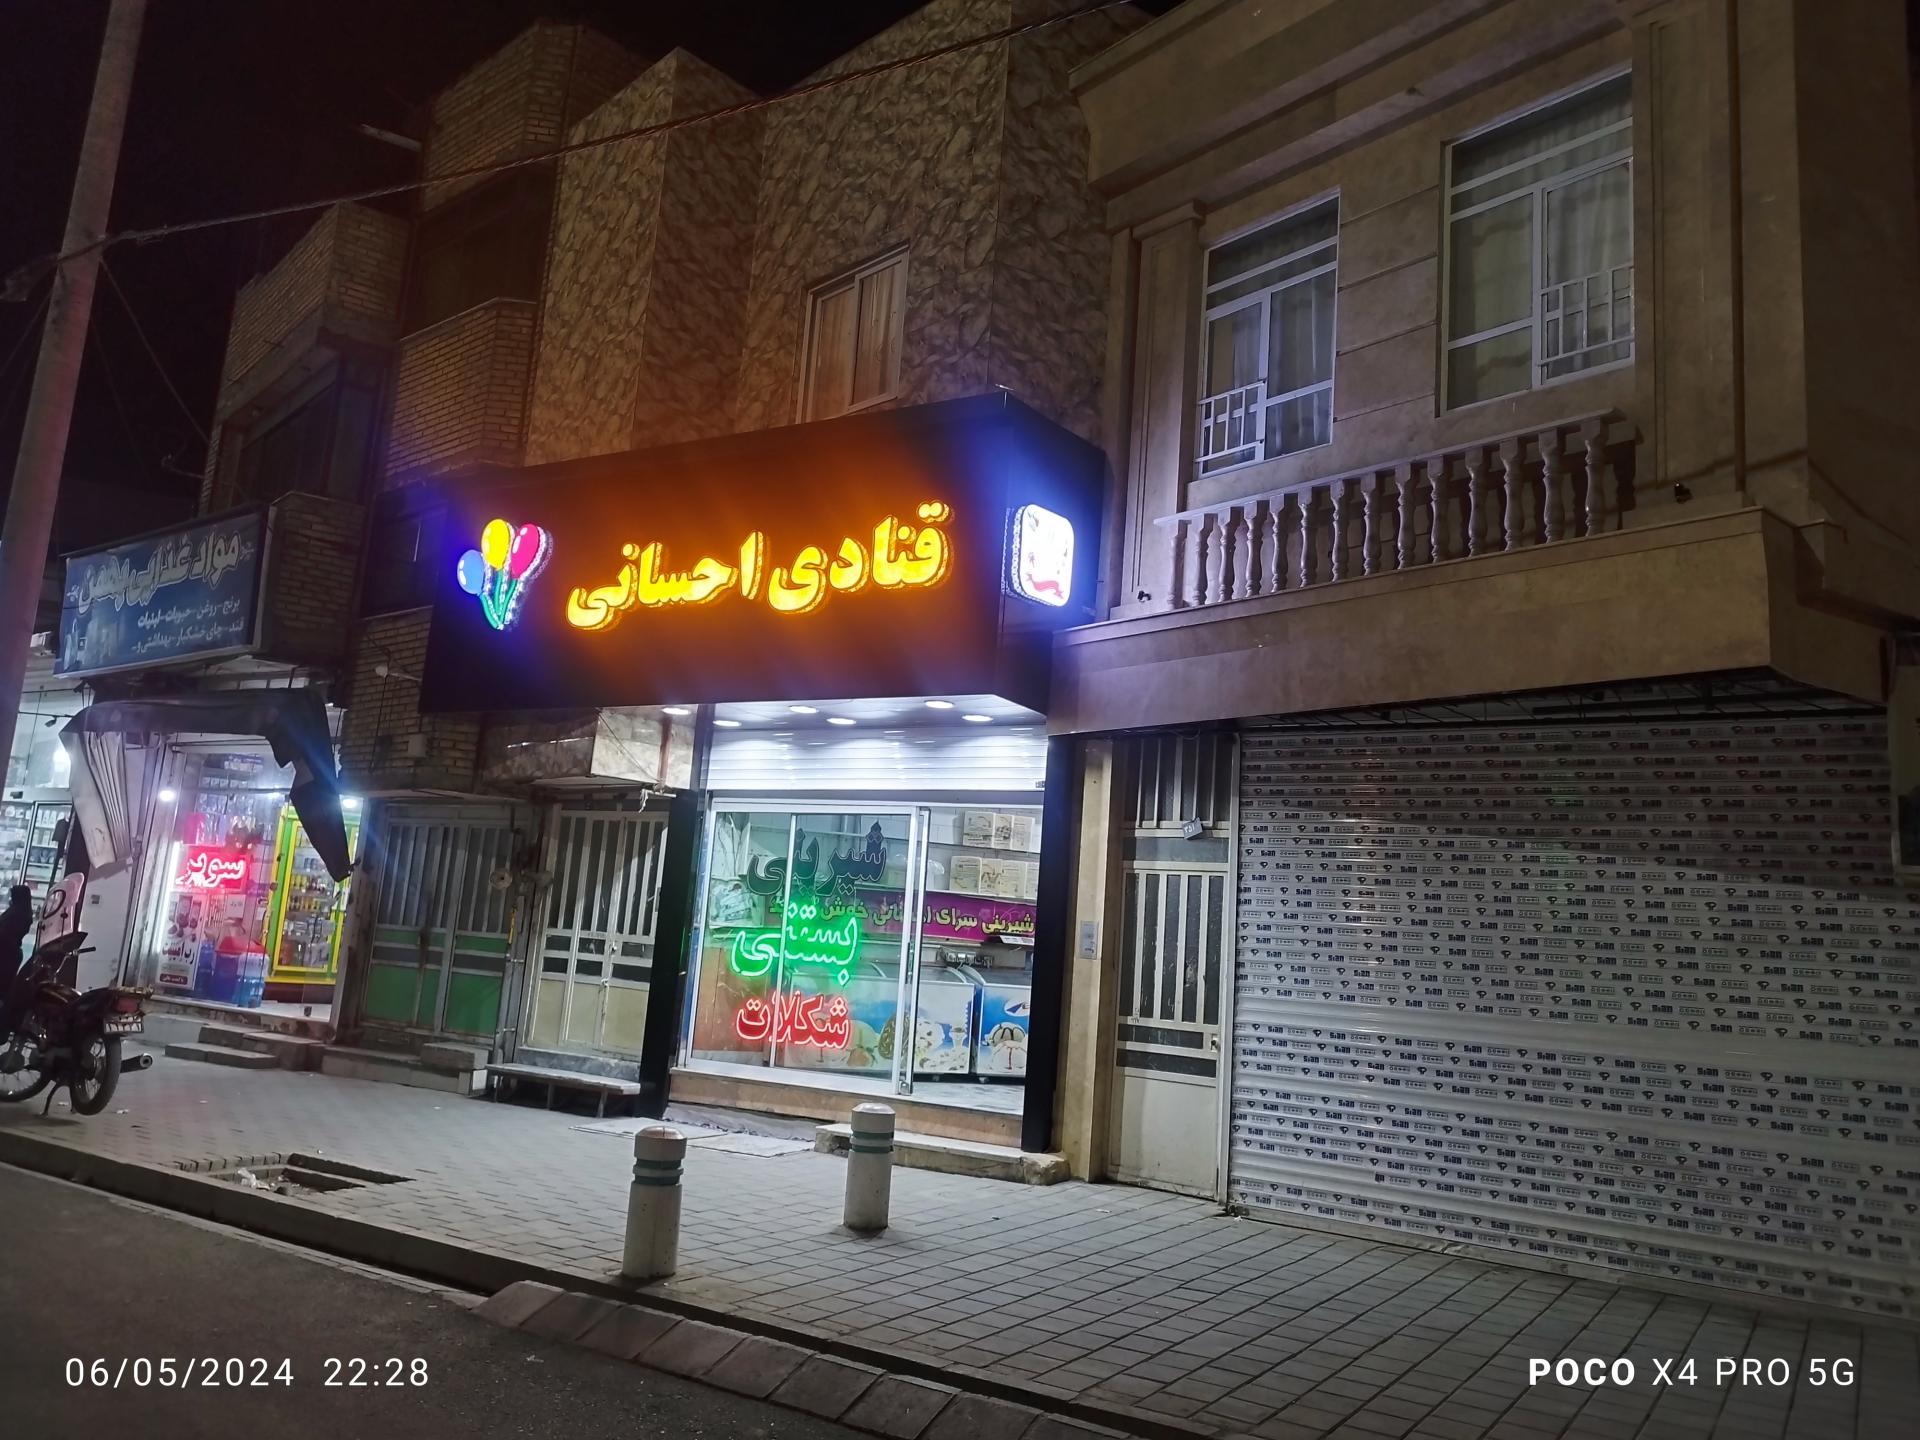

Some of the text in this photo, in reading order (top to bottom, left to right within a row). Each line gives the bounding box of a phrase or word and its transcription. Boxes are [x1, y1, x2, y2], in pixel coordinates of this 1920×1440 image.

[190, 528, 241, 590] مواد
[566, 501, 952, 630] قنادی احسانی
